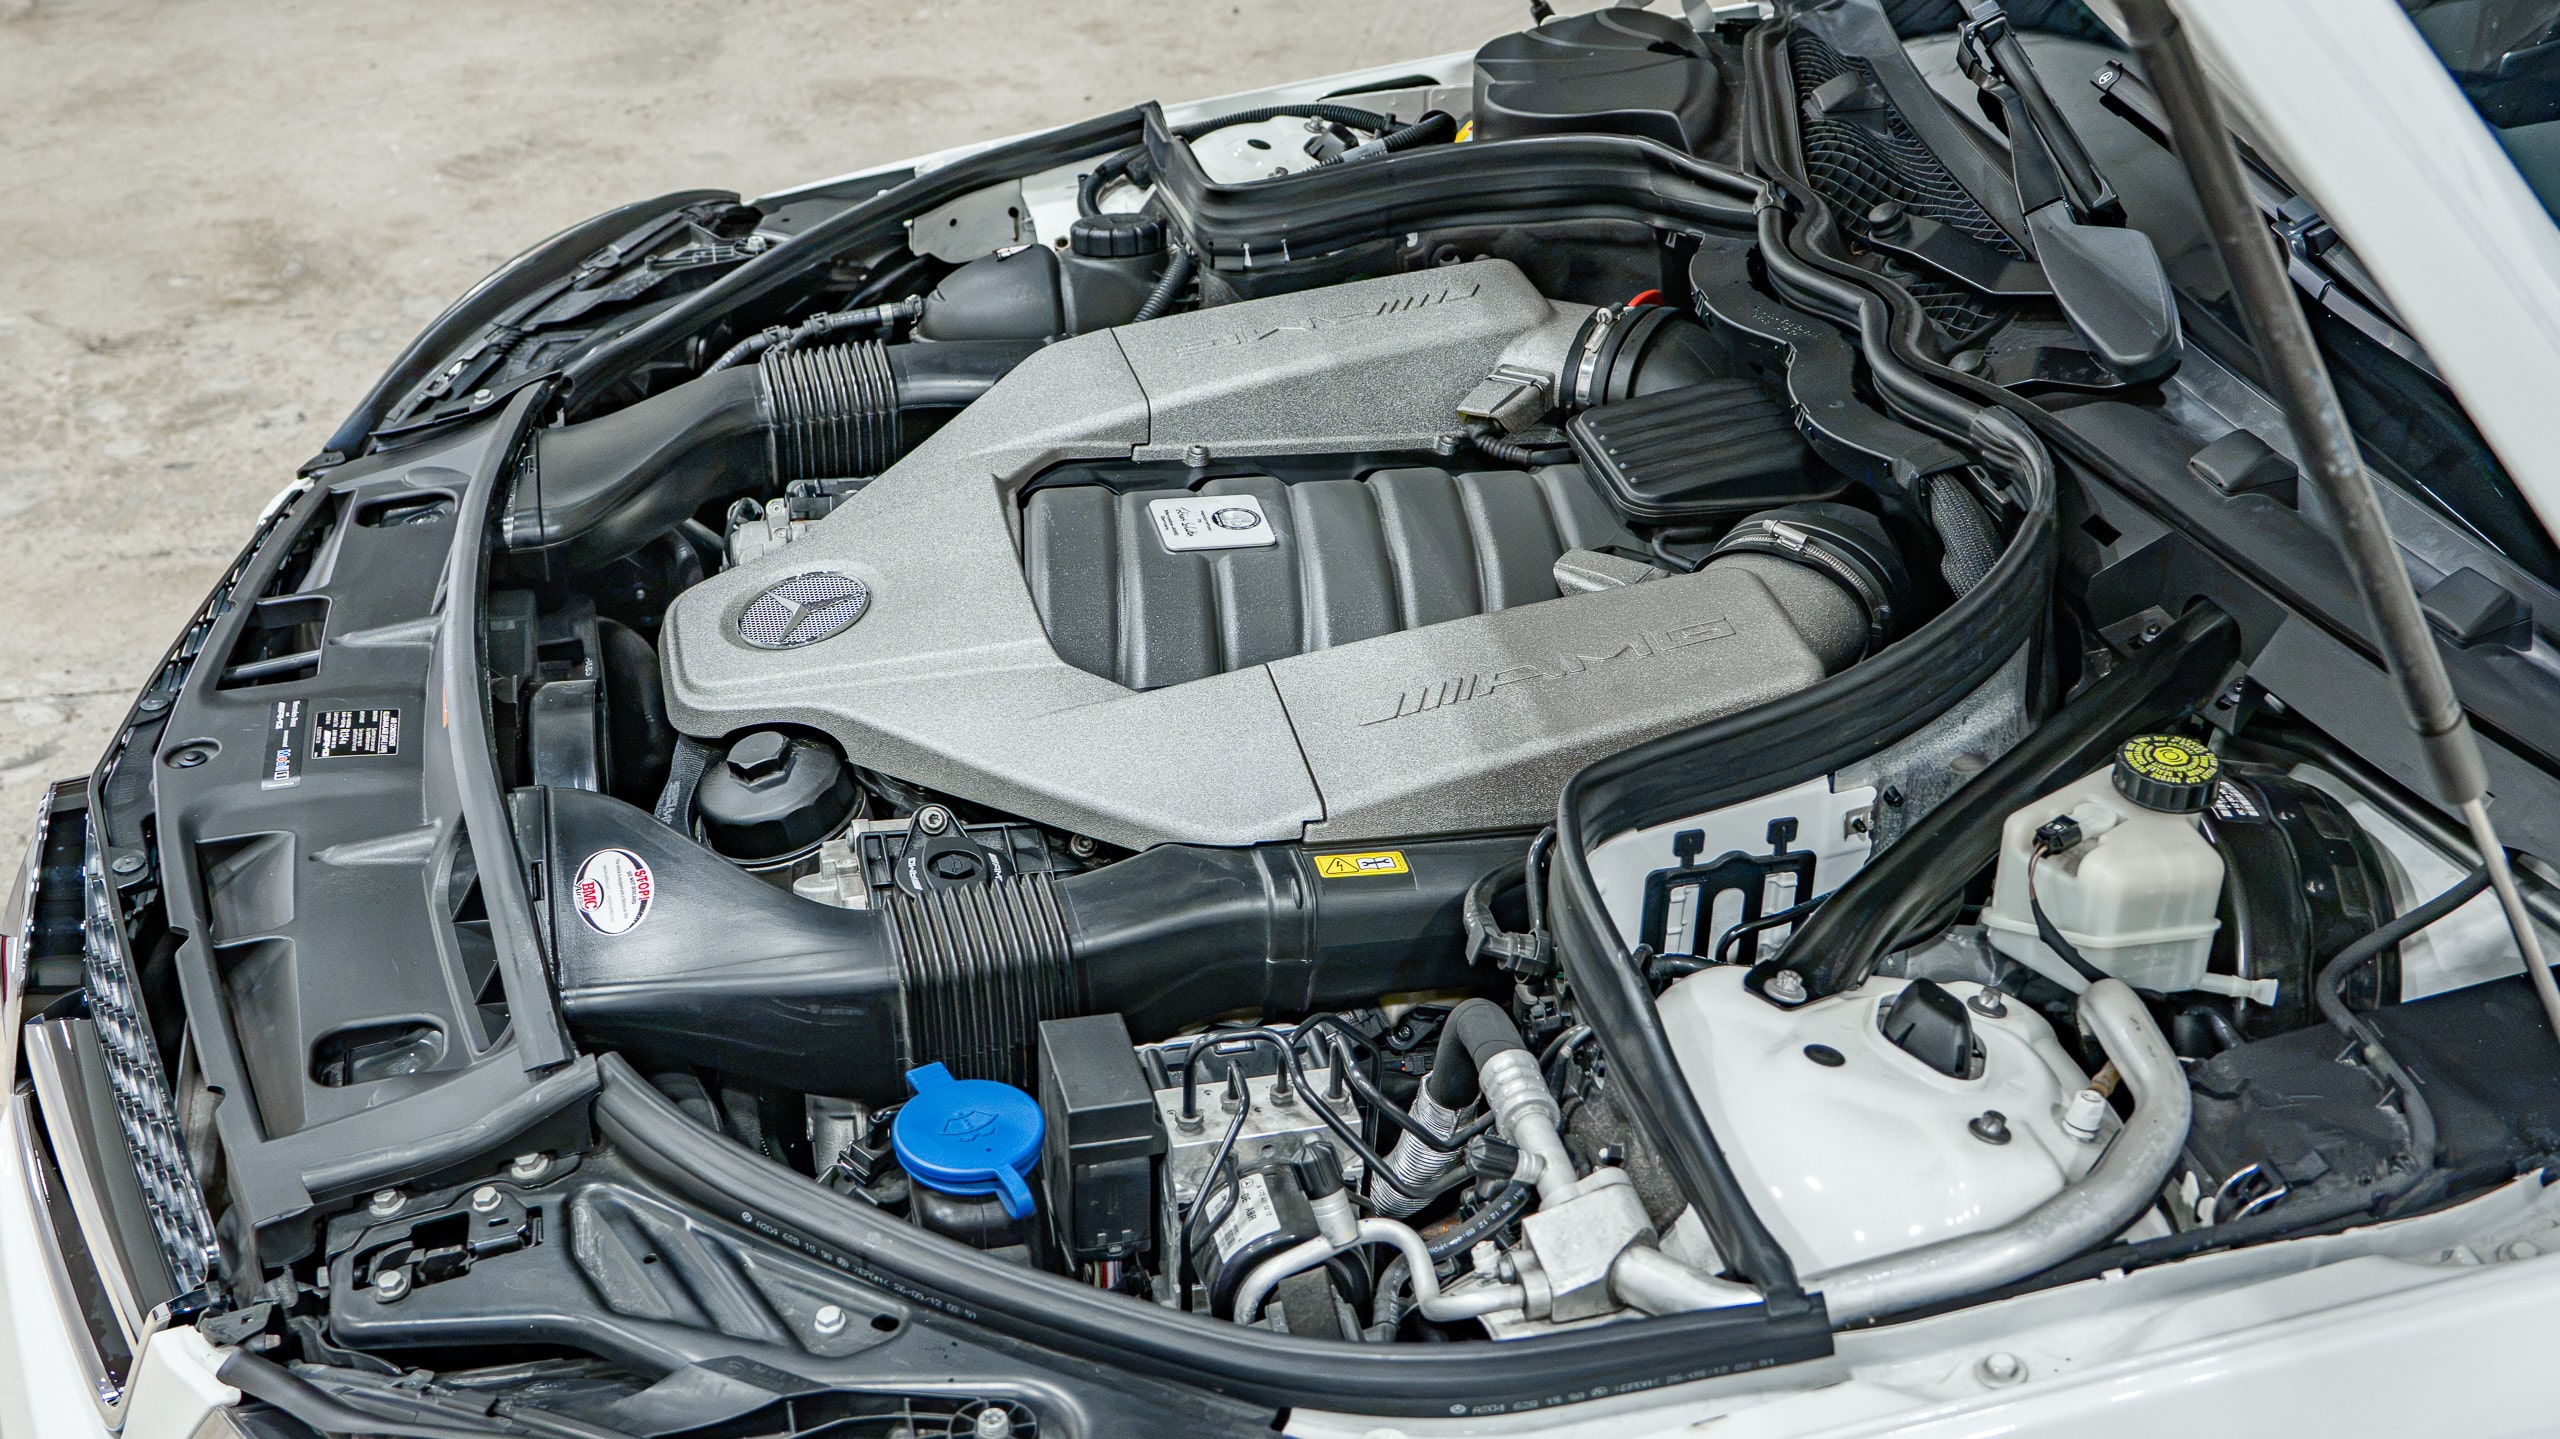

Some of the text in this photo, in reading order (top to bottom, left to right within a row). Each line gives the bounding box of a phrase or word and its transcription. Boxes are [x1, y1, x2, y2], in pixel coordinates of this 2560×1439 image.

[581, 881, 598, 910] BMC
[634, 869, 650, 901] STOP!
[1240, 1193, 1251, 1203] DE
